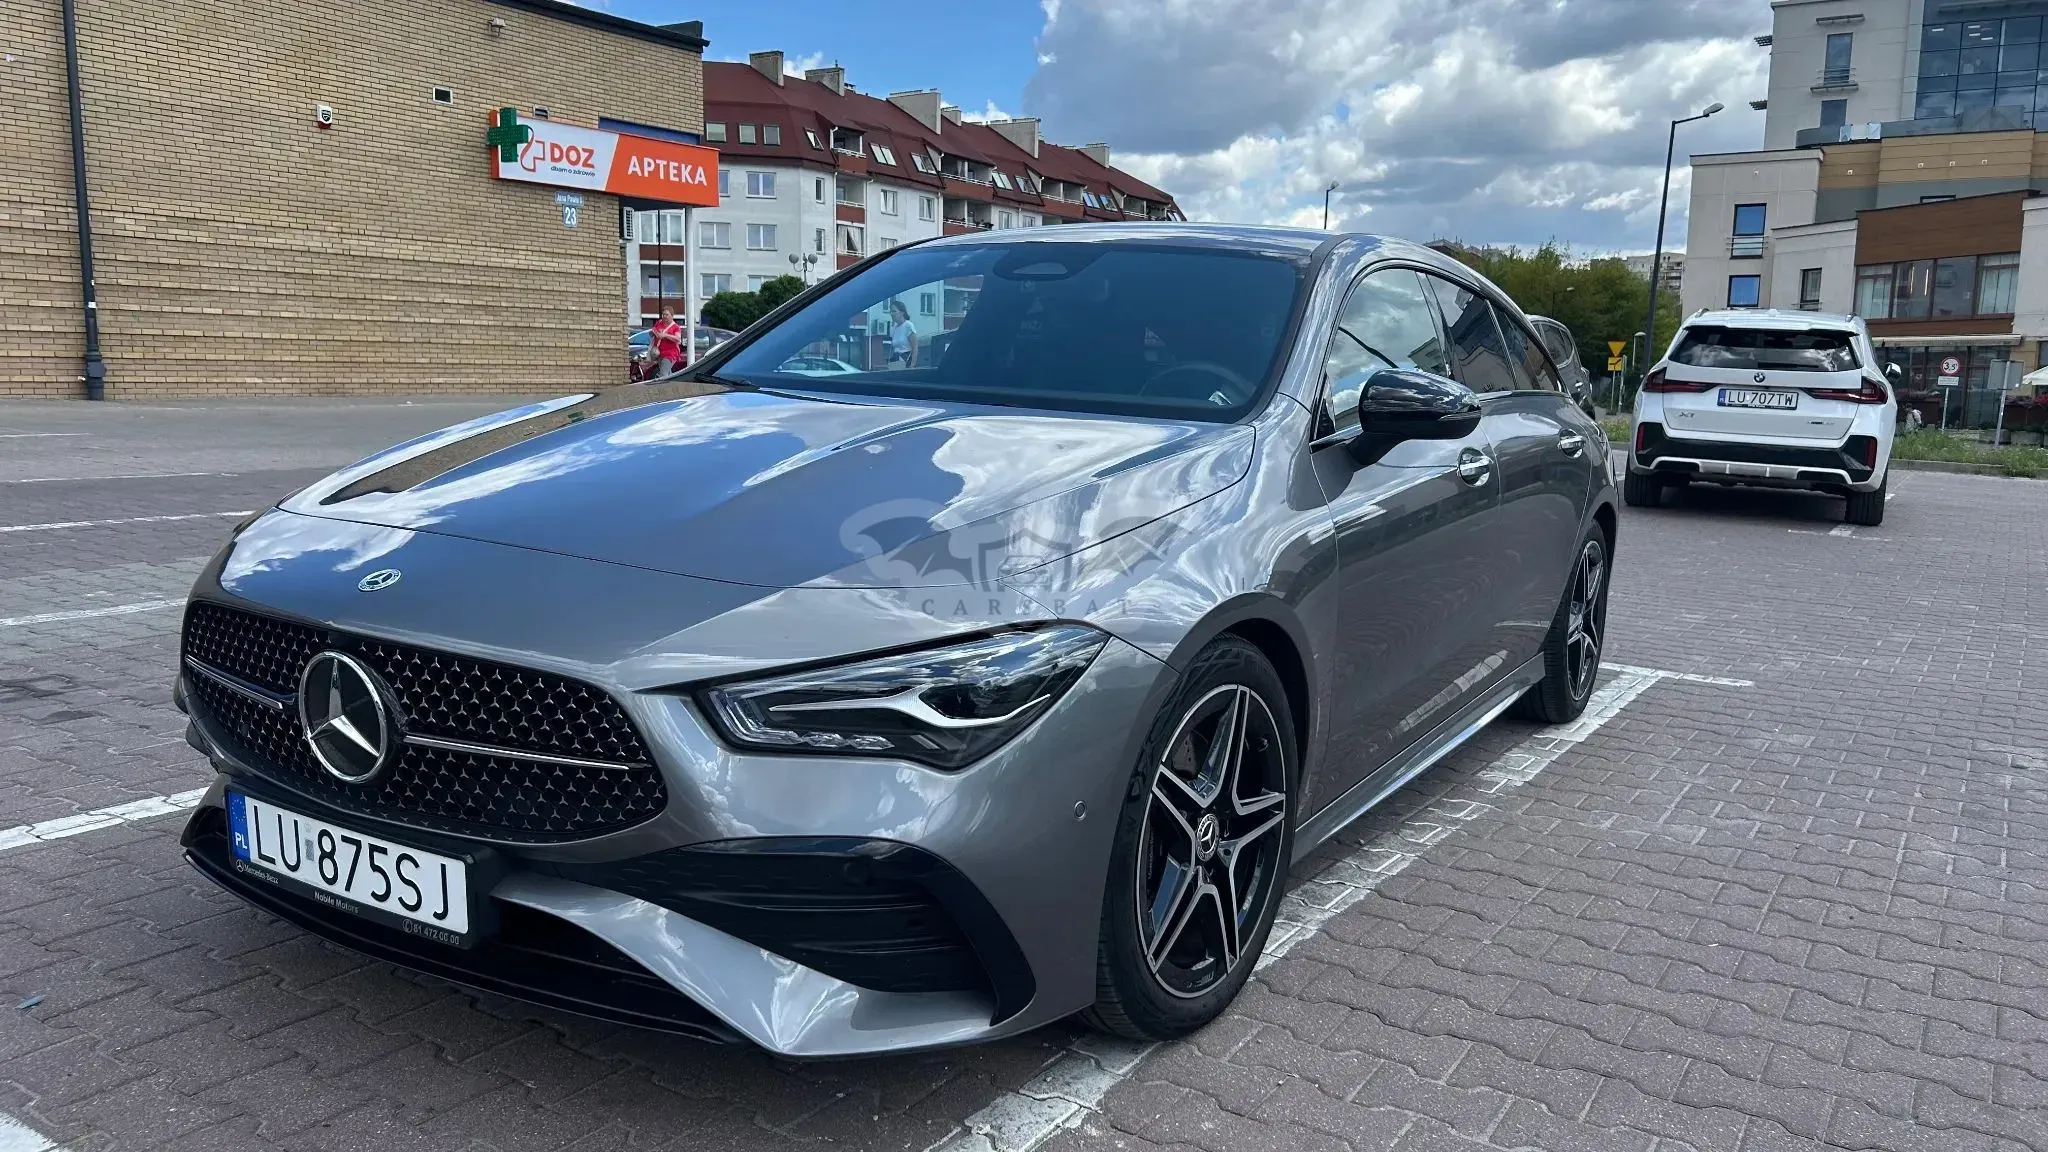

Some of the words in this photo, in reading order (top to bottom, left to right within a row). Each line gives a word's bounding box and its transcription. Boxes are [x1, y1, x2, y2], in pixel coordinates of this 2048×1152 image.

[550, 142, 595, 169] DOZ
[627, 155, 708, 187] APTEKA
[565, 206, 577, 226] 23
[1728, 391, 1746, 404] LU
[1751, 392, 1794, 406] 707TW
[235, 831, 248, 850] PL
[244, 863, 279, 885] Mercedes-Benz
[253, 805, 302, 873] LU
[317, 828, 449, 921] 875SJ
[314, 890, 335, 906] Nobile
[336, 899, 359, 914] Motors
[413, 923, 422, 934] 81
[424, 927, 438, 939] 472
